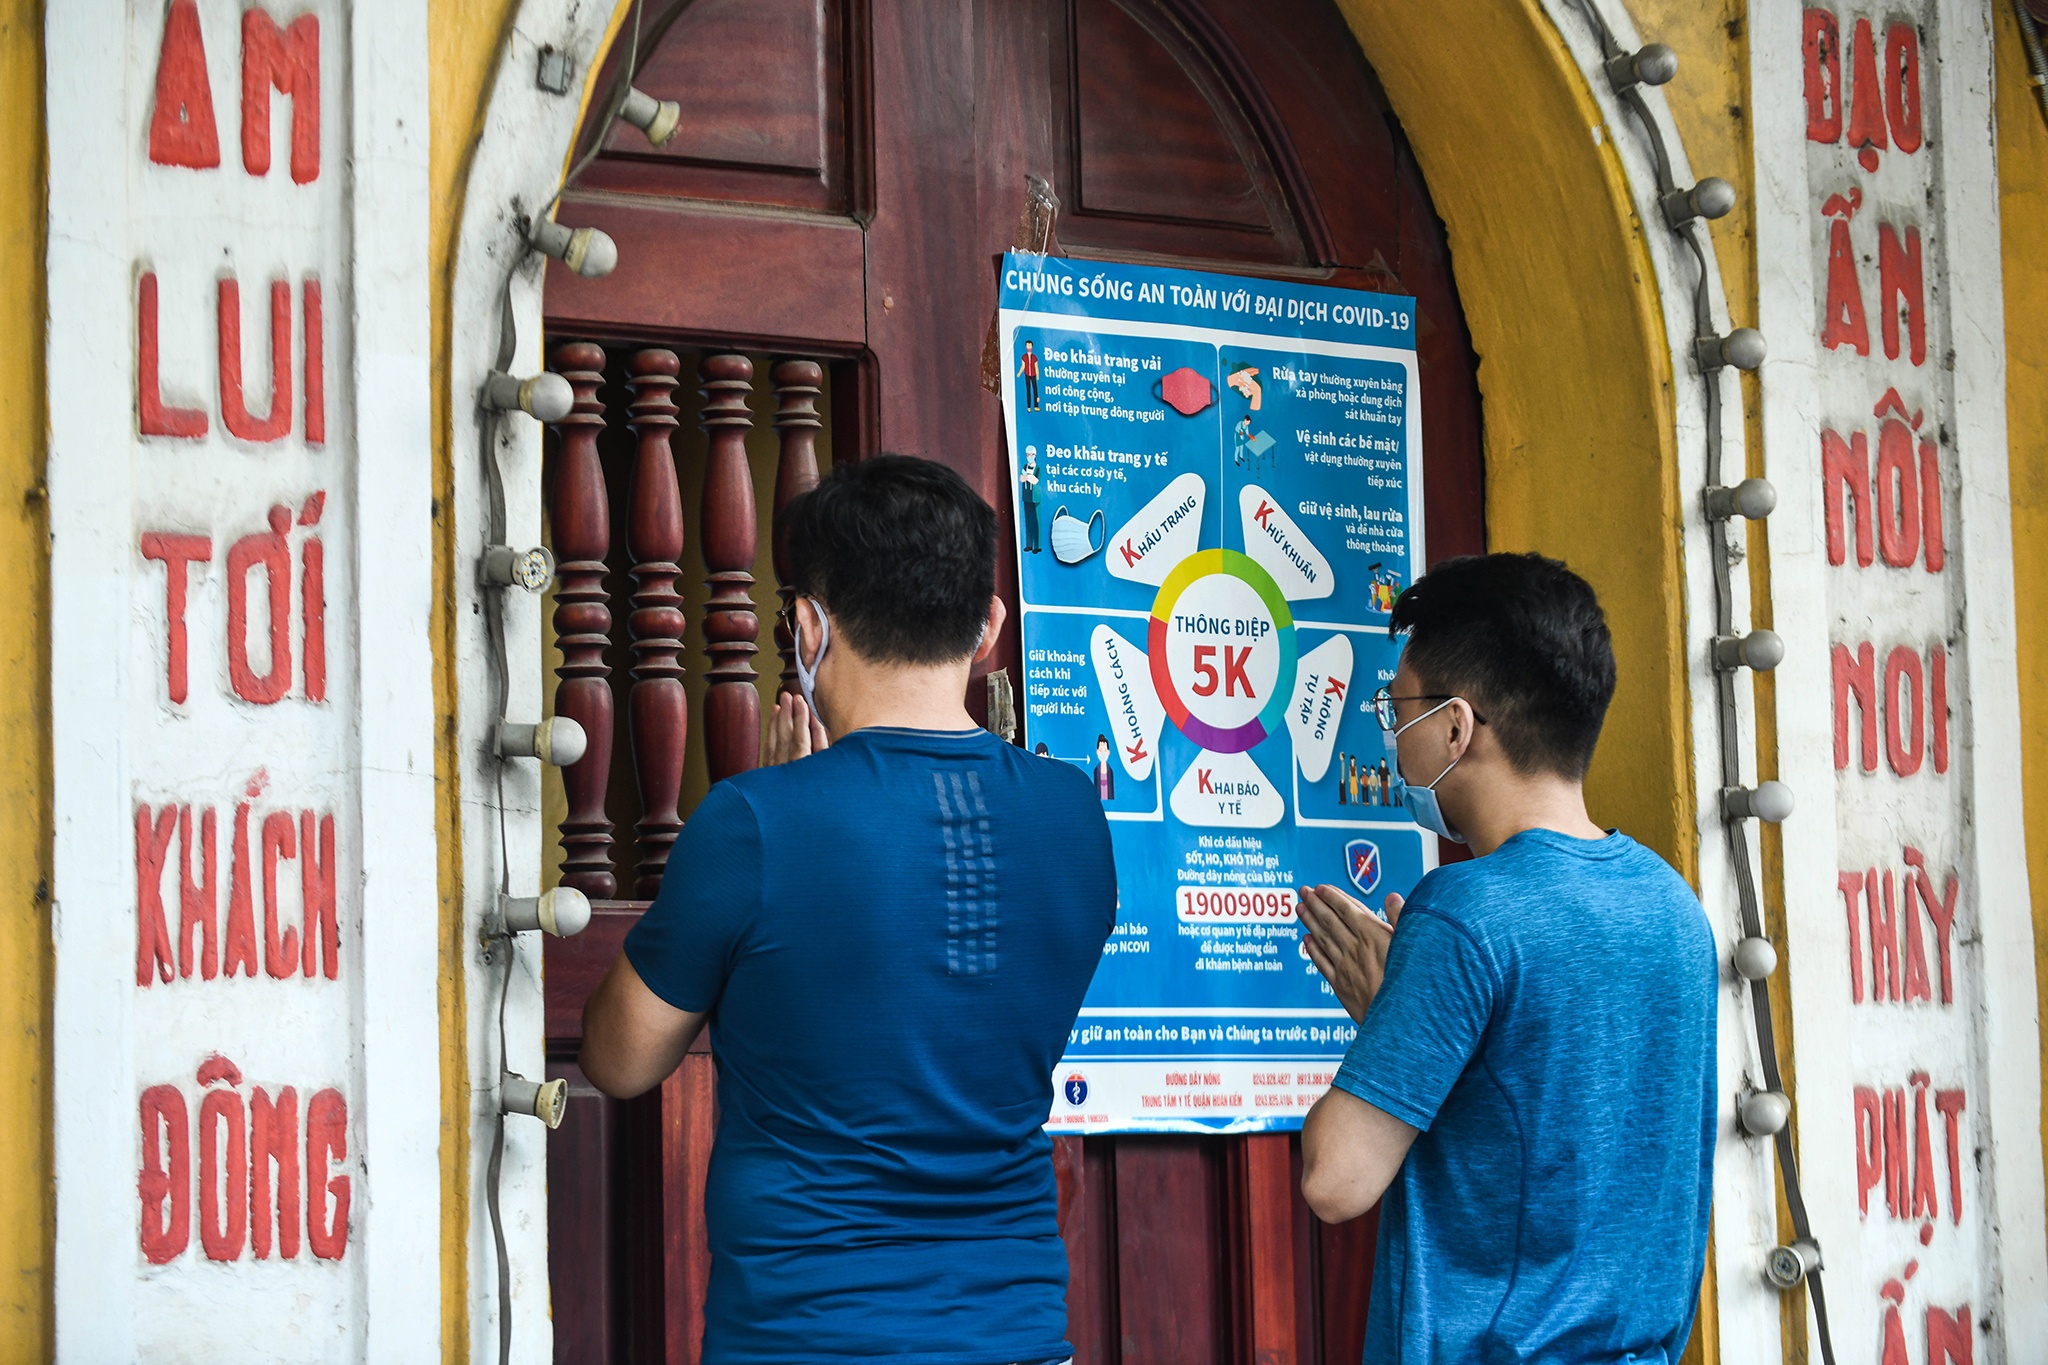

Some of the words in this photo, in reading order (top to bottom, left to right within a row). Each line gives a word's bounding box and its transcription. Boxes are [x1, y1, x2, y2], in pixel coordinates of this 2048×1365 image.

[1802, 8, 1922, 173] ĐẠO
[1005, 269, 1073, 296] CHUNG
[1078, 272, 1133, 301] SỐNG
[1137, 282, 1165, 304] AN
[1169, 284, 1217, 310] TOÀN
[1221, 288, 1251, 314] VỚI
[1254, 294, 1283, 323] ĐẠI
[1287, 298, 1328, 326] DỊCH
[1332, 303, 1410, 331] COVID-19
[139, 271, 325, 445] LUI
[1043, 347, 1068, 363] Đeo
[1103, 353, 1139, 372] trang
[1141, 355, 1161, 371] vải
[1043, 366, 1080, 382] thường
[1080, 371, 1111, 385] xuyên
[1112, 373, 1126, 387] tại
[1272, 366, 1296, 381] Rửa
[1298, 369, 1318, 386] tay
[1319, 373, 1352, 389] thường
[1353, 377, 1379, 391] xuyên
[1044, 384, 1061, 396] nơi
[1062, 385, 1086, 401] công
[1087, 388, 1115, 403] cộng,
[1295, 387, 1307, 398] xà
[1308, 388, 1337, 404] phòng
[1338, 390, 1359, 406] hoặc
[1360, 393, 1383, 409] dung
[1384, 395, 1402, 410] dịch
[1045, 401, 1061, 413] nơi
[1063, 402, 1080, 416] tập
[1081, 405, 1109, 420] trung
[1136, 409, 1165, 423] người
[1344, 408, 1359, 420] sát
[1388, 414, 1402, 427] tay
[1295, 429, 1311, 447] Vệ
[1312, 430, 1337, 446] sinh
[1338, 433, 1357, 448] các
[1046, 443, 1072, 459] Đeo
[1107, 449, 1142, 468] trang
[1143, 453, 1152, 468] y
[1154, 451, 1169, 467] tế
[1304, 450, 1319, 465] vật
[1320, 451, 1343, 468] dụng
[1343, 453, 1374, 471] thường
[1375, 458, 1402, 472] xuyên
[1046, 463, 1060, 478] tại
[1062, 464, 1079, 477] các
[1080, 466, 1093, 478] cơ
[1367, 474, 1385, 489] tiếp
[1385, 476, 1403, 489] xúc
[1047, 479, 1067, 493] khu
[1068, 481, 1092, 495] cách
[1093, 483, 1102, 498] ly
[1160, 495, 1197, 534] TRANG
[1253, 499, 1285, 543] KHỬ
[1298, 500, 1318, 516] Giữ
[1319, 502, 1332, 520] vệ
[1334, 503, 1362, 522] sinh,
[1363, 505, 1380, 521] lau
[1345, 522, 1356, 534] và
[1368, 524, 1384, 537] nhà
[1346, 538, 1371, 554] thông
[140, 489, 326, 705] TỚI
[1175, 613, 1231, 635] THÔNG
[1234, 616, 1270, 642] ĐIỆP
[1028, 649, 1046, 662] Giữ
[1047, 650, 1086, 667] khoảng
[1105, 638, 1124, 679] CÁCH
[1029, 667, 1053, 679] cách
[1054, 667, 1071, 680] khi
[1191, 644, 1257, 699] 5K
[1029, 683, 1050, 699] tiếp
[1052, 685, 1070, 697] xúc
[1071, 685, 1087, 698] với
[1304, 673, 1319, 694] TỤ
[1030, 702, 1058, 717] người
[1060, 702, 1085, 715] khác
[1299, 696, 1313, 725] TẬP
[1314, 675, 1346, 741] KHÔNG
[1831, 640, 1948, 778] NOI
[1118, 683, 1148, 764] KHOẢNG
[1198, 768, 1234, 795] KHAI
[1237, 780, 1260, 796] BÁO
[1218, 802, 1226, 815] Y
[1228, 798, 1242, 816] TẾ
[1198, 835, 1213, 848] Khi
[1213, 836, 1225, 848] có
[1242, 837, 1262, 852] hiệu
[1206, 852, 1223, 867] HO,
[1223, 851, 1244, 866] KHÓ
[1265, 855, 1279, 870] gọi
[135, 765, 338, 988] KHÁCH
[1205, 869, 1223, 885] dây
[1223, 869, 1247, 886] nóng
[1263, 870, 1276, 886] Bộ
[1184, 891, 1292, 918] 19009095
[1129, 922, 1149, 936] báo
[1211, 925, 1235, 939] quan
[1119, 940, 1150, 953] NCOVI
[1205, 957, 1231, 971] khám
[1231, 957, 1253, 974] bệnh
[1253, 960, 1265, 971] an
[1264, 959, 1283, 972] toàn
[1081, 1025, 1103, 1045] giữ
[1105, 1029, 1121, 1041] an
[1123, 1024, 1153, 1041] toàn
[1155, 1025, 1178, 1041] cho
[1181, 1026, 1207, 1044] Bạn
[1209, 1024, 1224, 1041] và
[1225, 1024, 1260, 1045] Chúng
[1261, 1026, 1273, 1041] ta
[1275, 1025, 1308, 1041] trước
[1310, 1025, 1331, 1045] Đại
[137, 1050, 351, 1265] ĐÔNG
[1853, 1071, 1966, 1246] PHẬT
